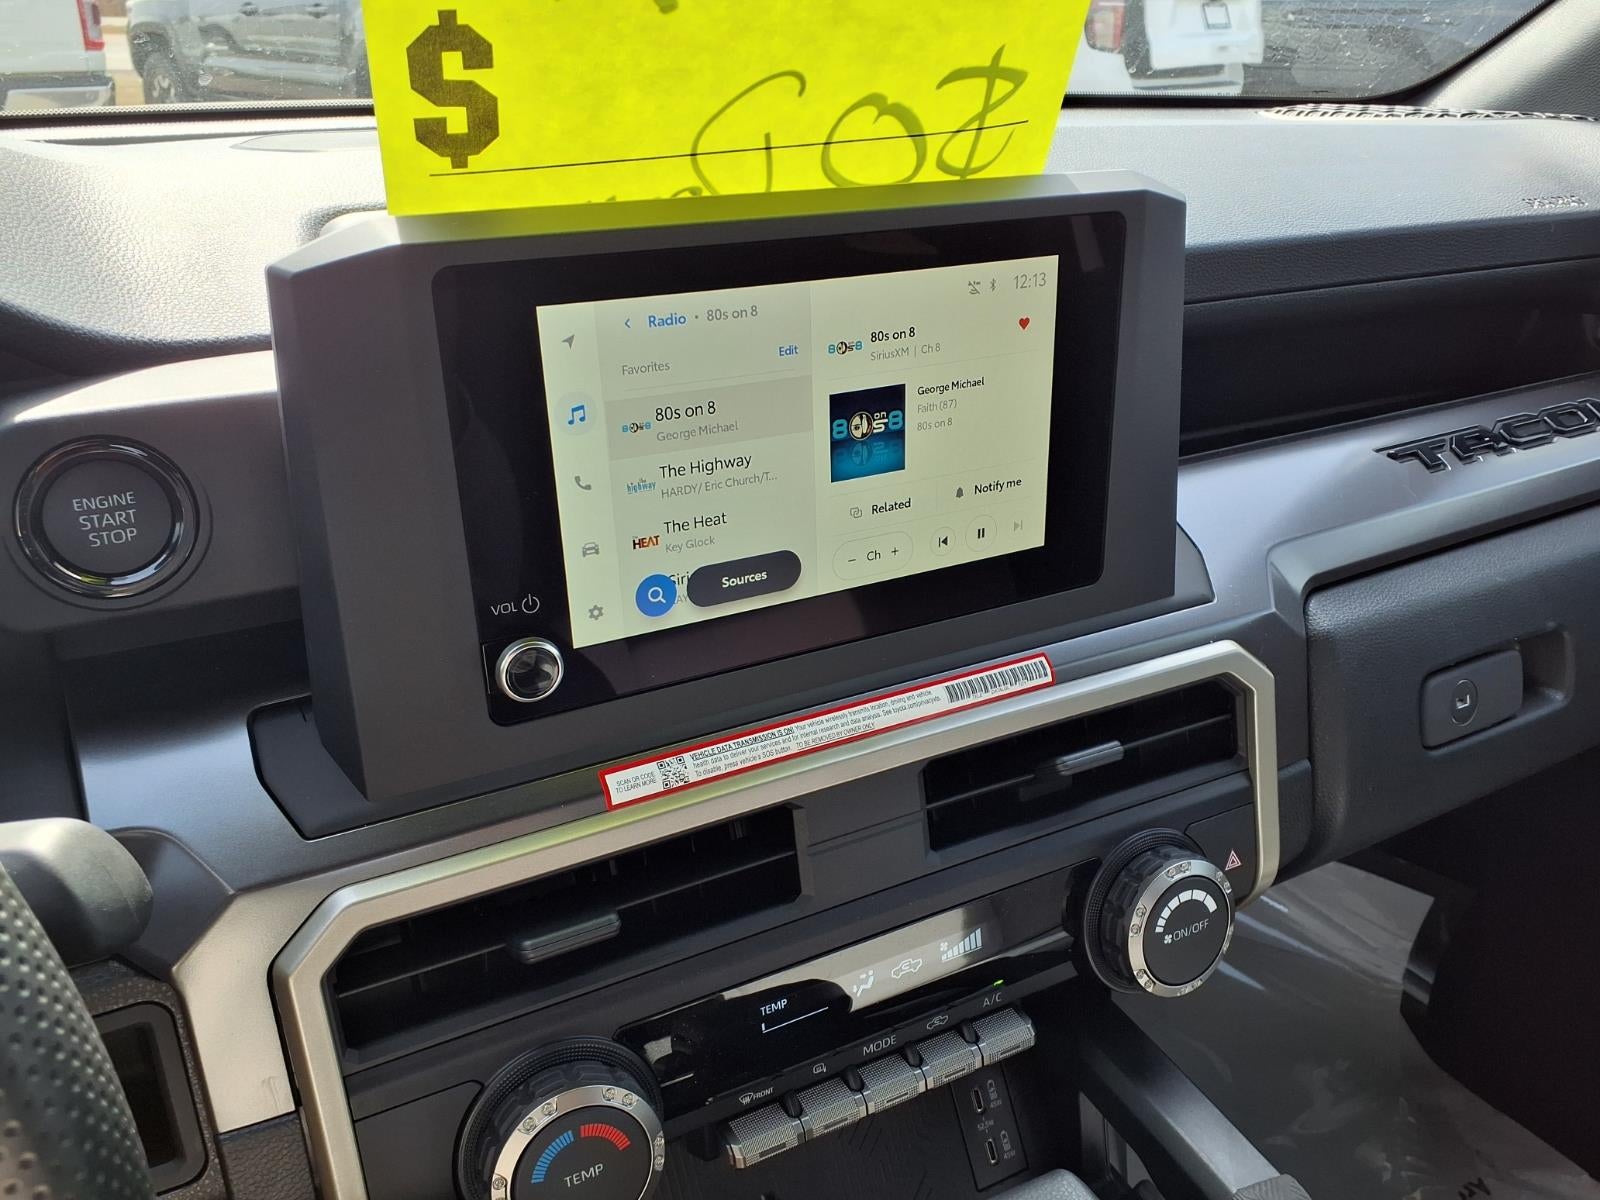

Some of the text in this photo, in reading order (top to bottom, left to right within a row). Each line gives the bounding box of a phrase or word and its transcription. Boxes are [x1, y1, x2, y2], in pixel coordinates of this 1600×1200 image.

[405, 9, 501, 169] $
[1013, 272, 1047, 290] 12:13
[648, 305, 758, 328] Radio 80s on 8
[870, 327, 916, 343] 80s on 8
[778, 344, 799, 357] Edit
[870, 343, 941, 361] SiriusXM Ch 8
[621, 360, 670, 376] Favorites
[917, 377, 985, 396] George Michael
[655, 401, 717, 422] 80s on 8
[917, 399, 957, 414] Faith (87)
[656, 421, 739, 442] George Michael
[917, 417, 953, 431] 80s on 8
[659, 455, 752, 479] The Highway
[705, 481, 723, 491] Eric
[974, 478, 1022, 495] Notify me
[73, 491, 136, 511] ENGINE
[871, 498, 911, 515] Related
[79, 509, 136, 530] START
[664, 512, 727, 534] The Heat
[88, 527, 137, 547] STOP
[633, 535, 660, 549] HEAT
[665, 536, 715, 554] Key Glock
[867, 550, 881, 561] Ch
[722, 570, 767, 588] Sources
[491, 602, 518, 616] VOL
[689, 747, 715, 760] VEHICLE
[716, 742, 732, 753] DATA
[732, 730, 776, 748] TRANSMISSION
[807, 718, 824, 728] vehicle
[761, 749, 774, 758] SOS
[616, 777, 631, 786] SCAN
[623, 781, 640, 791] LEARN
[641, 777, 656, 786] MORE
[1173, 919, 1209, 941] ON/OFF
[760, 999, 788, 1017] TEMP
[982, 992, 1002, 1008] A/C
[862, 1035, 897, 1057] MODE
[753, 1087, 775, 1101] FRONT
[564, 1163, 604, 1188] TEMP
